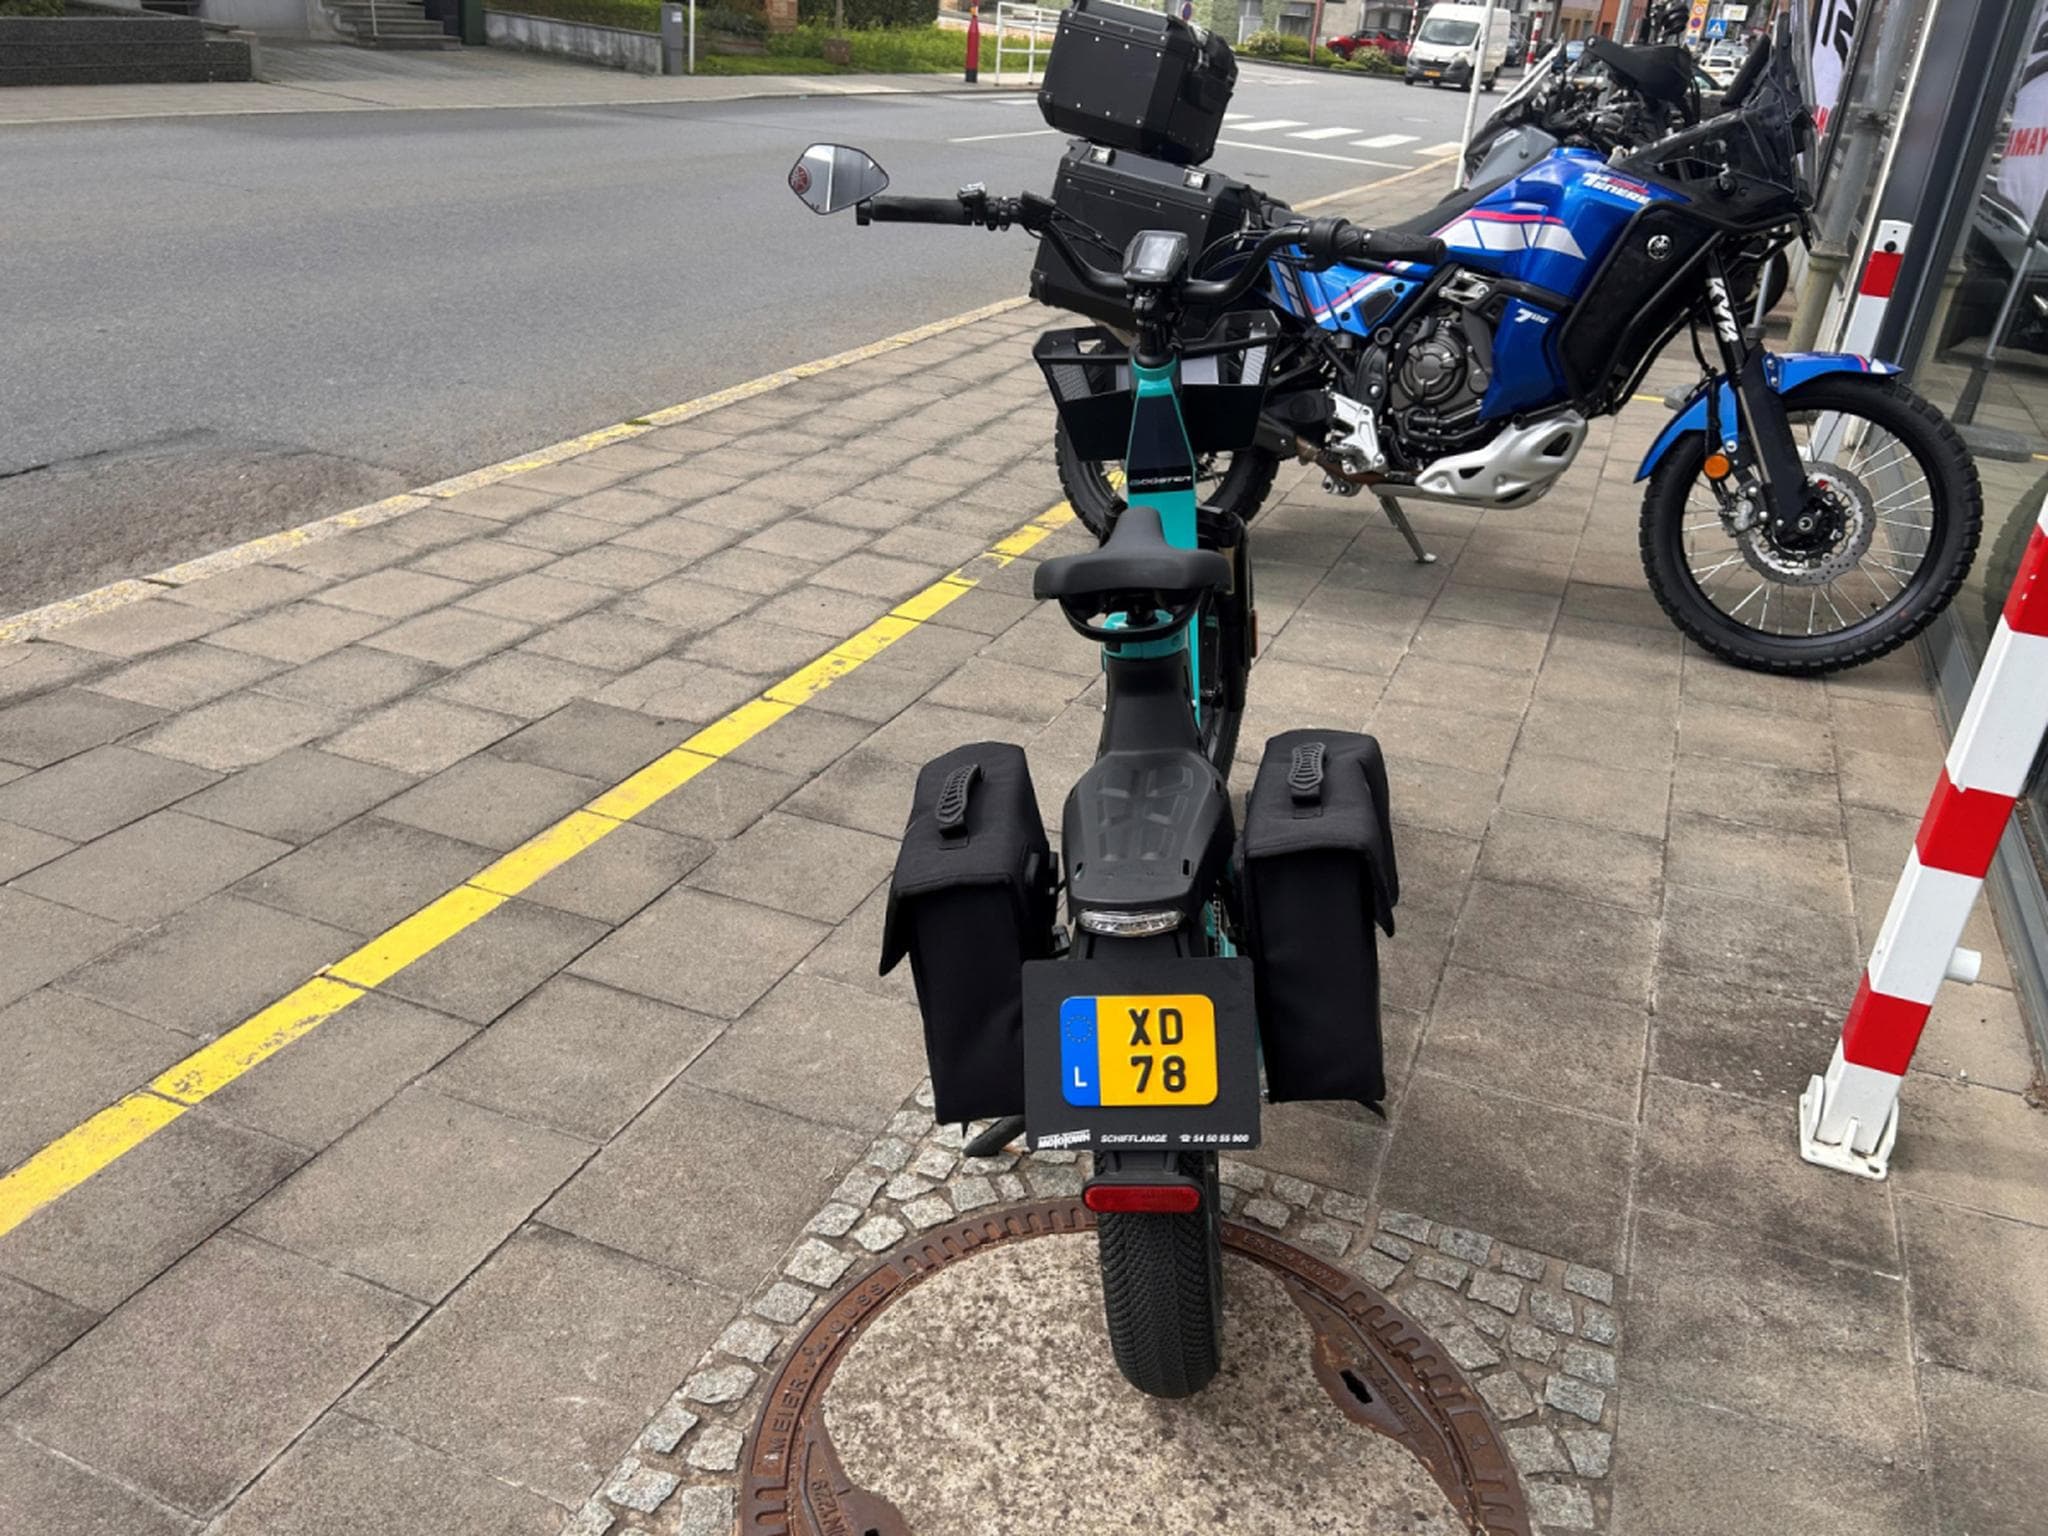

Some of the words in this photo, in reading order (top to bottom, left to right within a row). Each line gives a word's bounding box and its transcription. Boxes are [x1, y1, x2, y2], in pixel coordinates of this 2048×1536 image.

[1706, 277, 1738, 342] KYB
[1128, 1007, 1183, 1046] XD
[1074, 1066, 1088, 1087] L
[1130, 1055, 1187, 1093] 78
[1100, 1133, 1168, 1143] SCHIFFLANGE
[1192, 1133, 1204, 1143] 54
